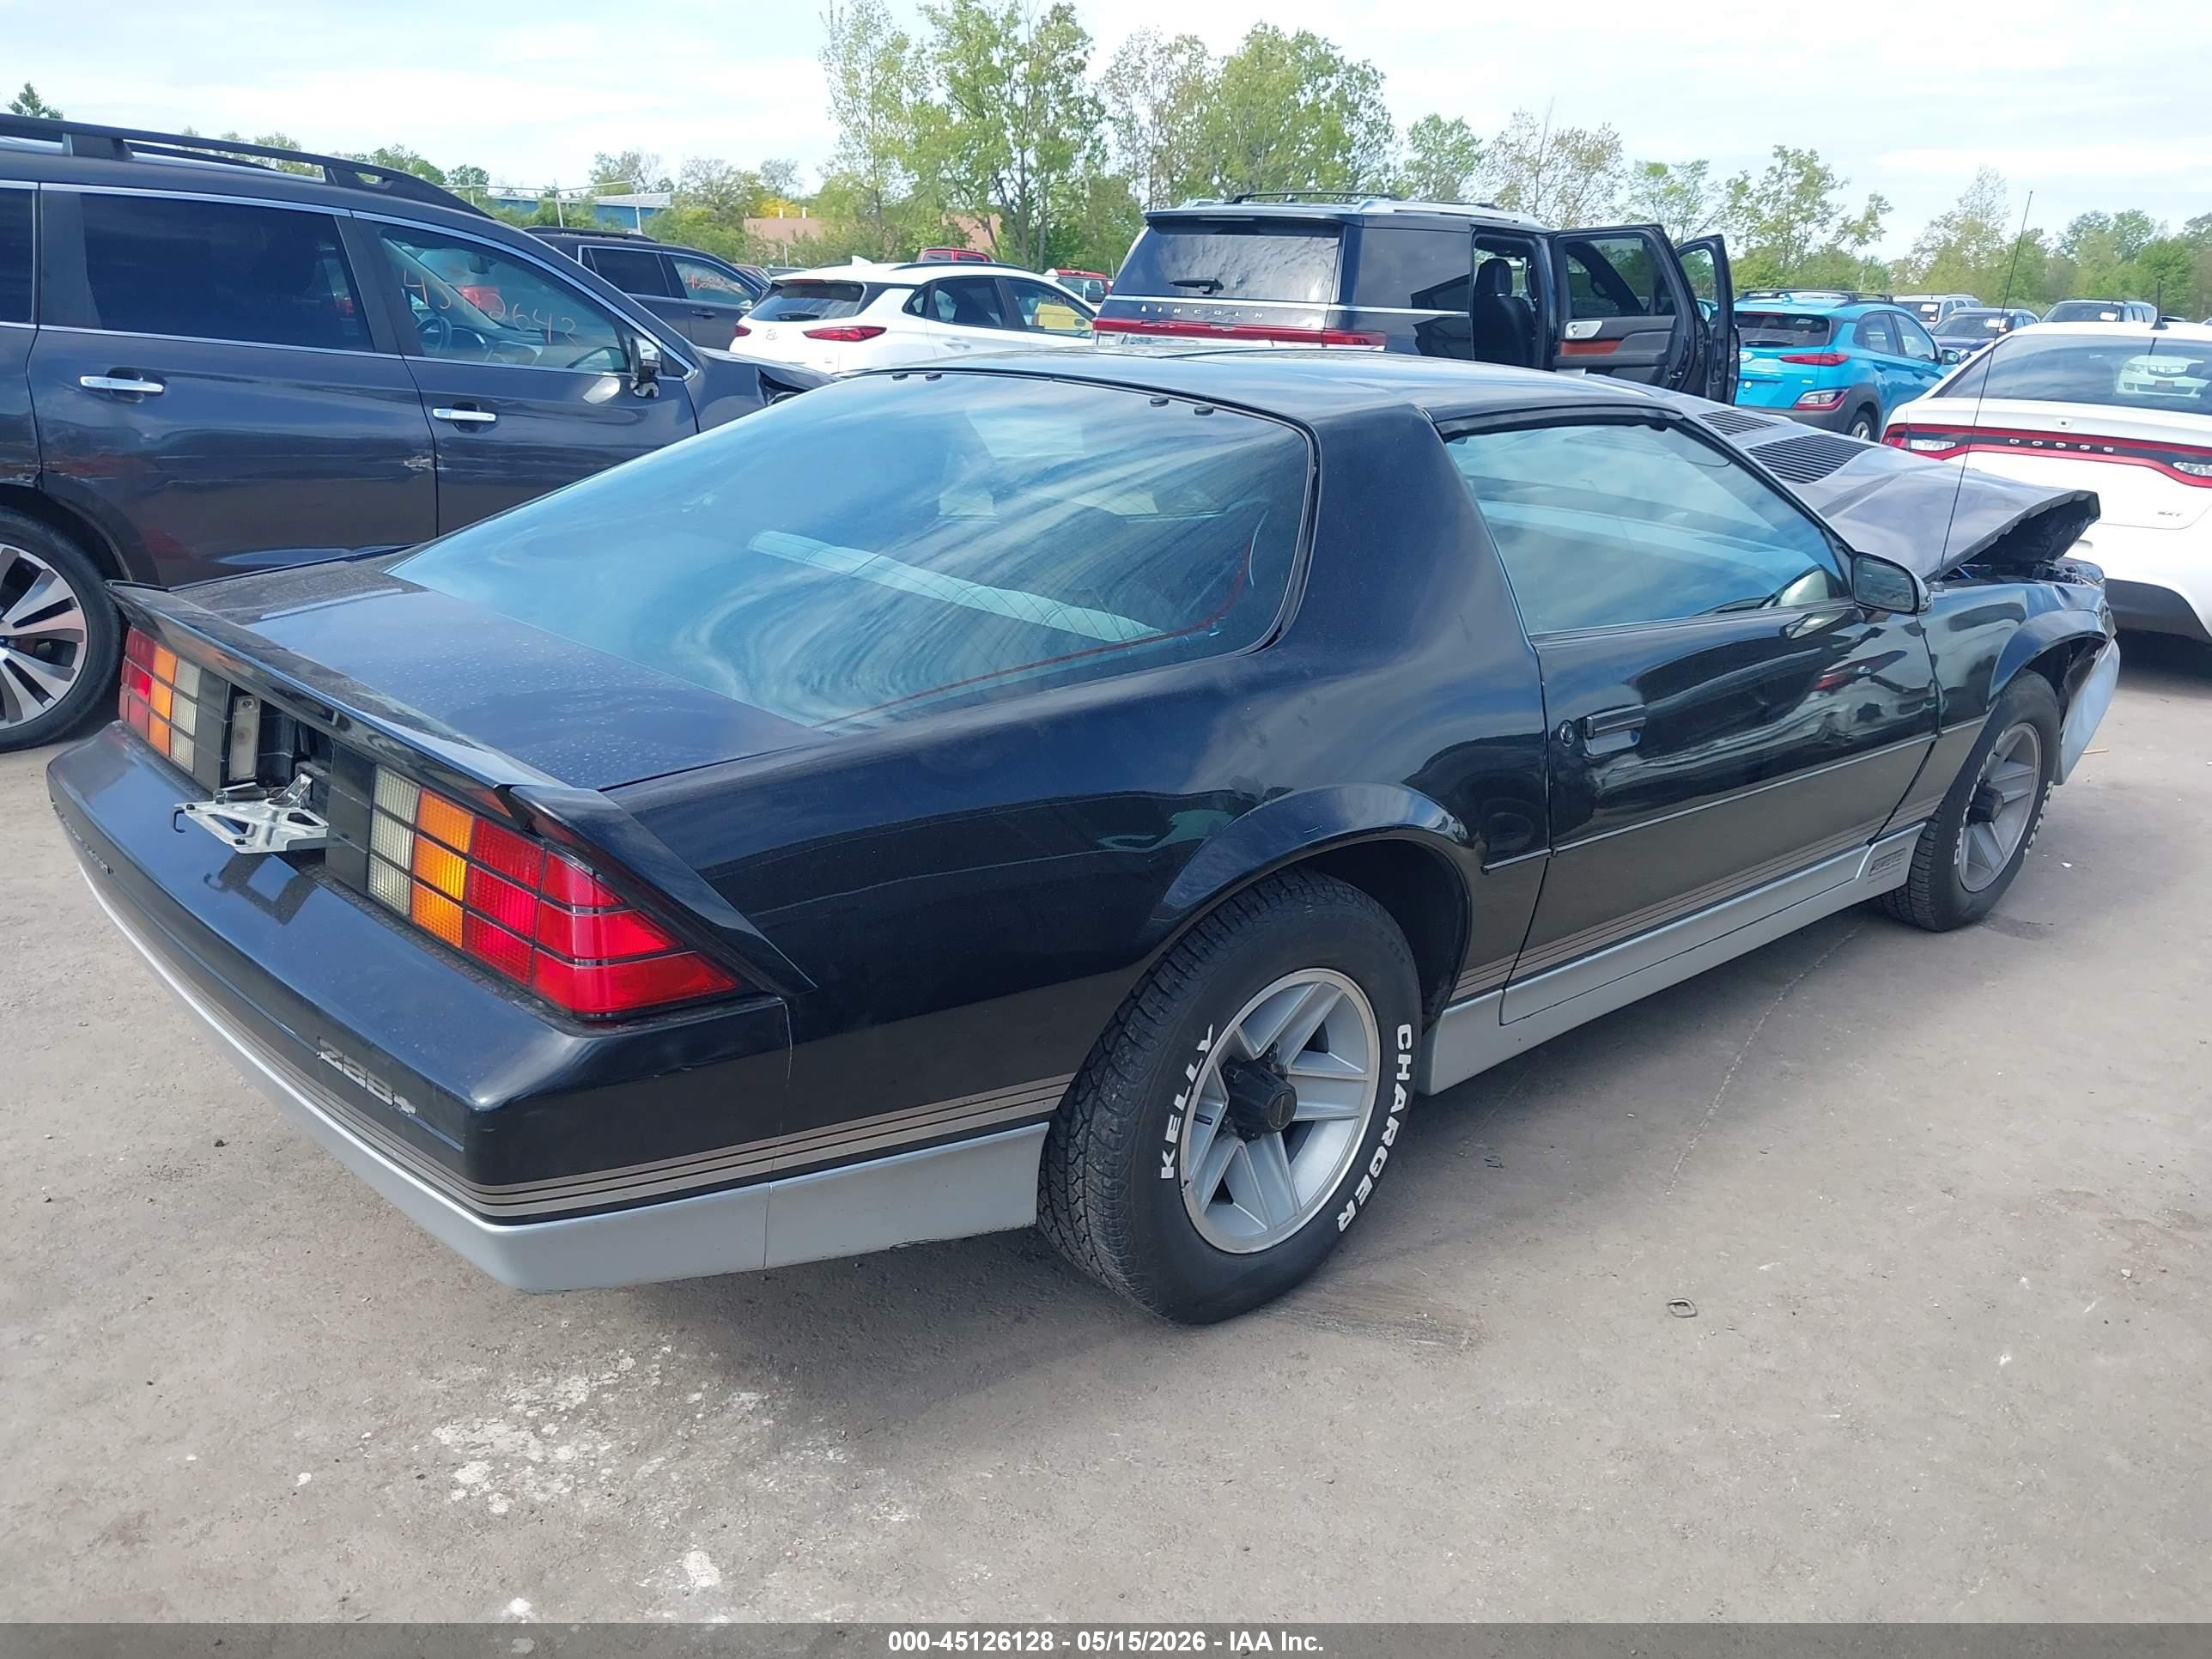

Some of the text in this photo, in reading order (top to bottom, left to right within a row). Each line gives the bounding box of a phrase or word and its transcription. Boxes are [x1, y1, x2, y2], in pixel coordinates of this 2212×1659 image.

[1139, 303, 1263, 319] LINCOLN
[1161, 1024, 1213, 1178] KELLY
[1336, 1024, 1413, 1233] CHARGER
